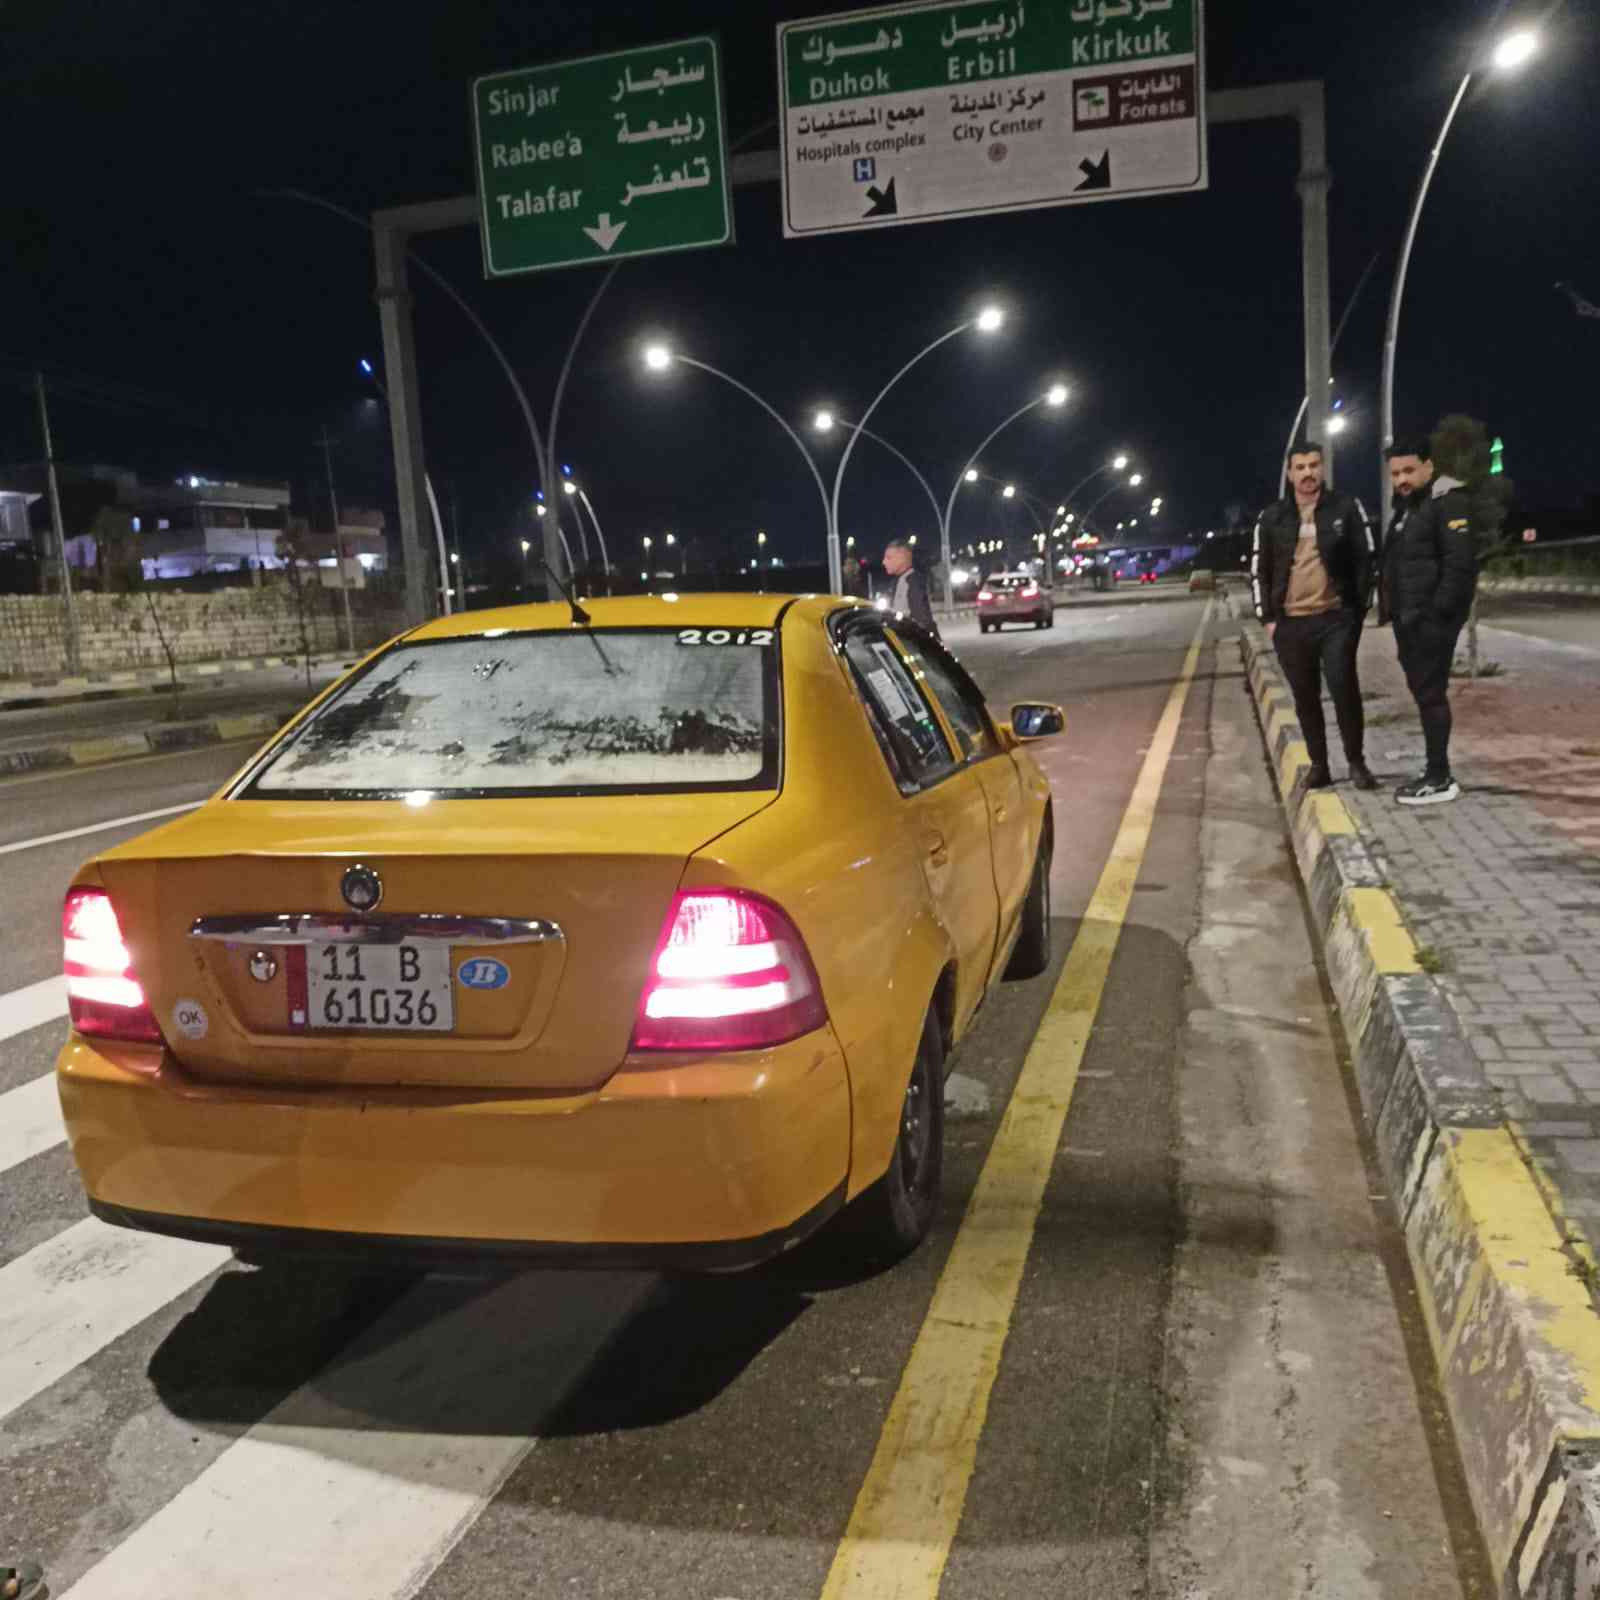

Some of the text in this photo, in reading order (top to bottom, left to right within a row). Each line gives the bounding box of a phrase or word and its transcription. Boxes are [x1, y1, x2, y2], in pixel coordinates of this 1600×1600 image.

[941, 1, 1026, 47] أربيل
[802, 27, 904, 65] دهوك
[1071, 24, 1170, 64] Kirkuk
[610, 56, 706, 103] سنجار
[947, 48, 1017, 81] Erbil
[488, 83, 560, 117] Sinjar
[809, 67, 891, 100] Duhok
[949, 87, 1046, 119] مركز المدينة
[1120, 98, 1186, 120] Forests
[613, 111, 706, 146] ربيعة
[797, 104, 926, 138] مجمع المستشفيات
[953, 117, 1045, 143] City Center
[491, 130, 583, 168] Rabee'a
[796, 131, 926, 163] Hospitals complex
[619, 155, 711, 207] تلعفر
[856, 159, 874, 180] H
[496, 185, 583, 220] Talafar
[678, 628, 774, 646] 2012
[322, 944, 421, 983] 11 B
[178, 1010, 202, 1025] OK
[323, 986, 438, 1026] 61036
